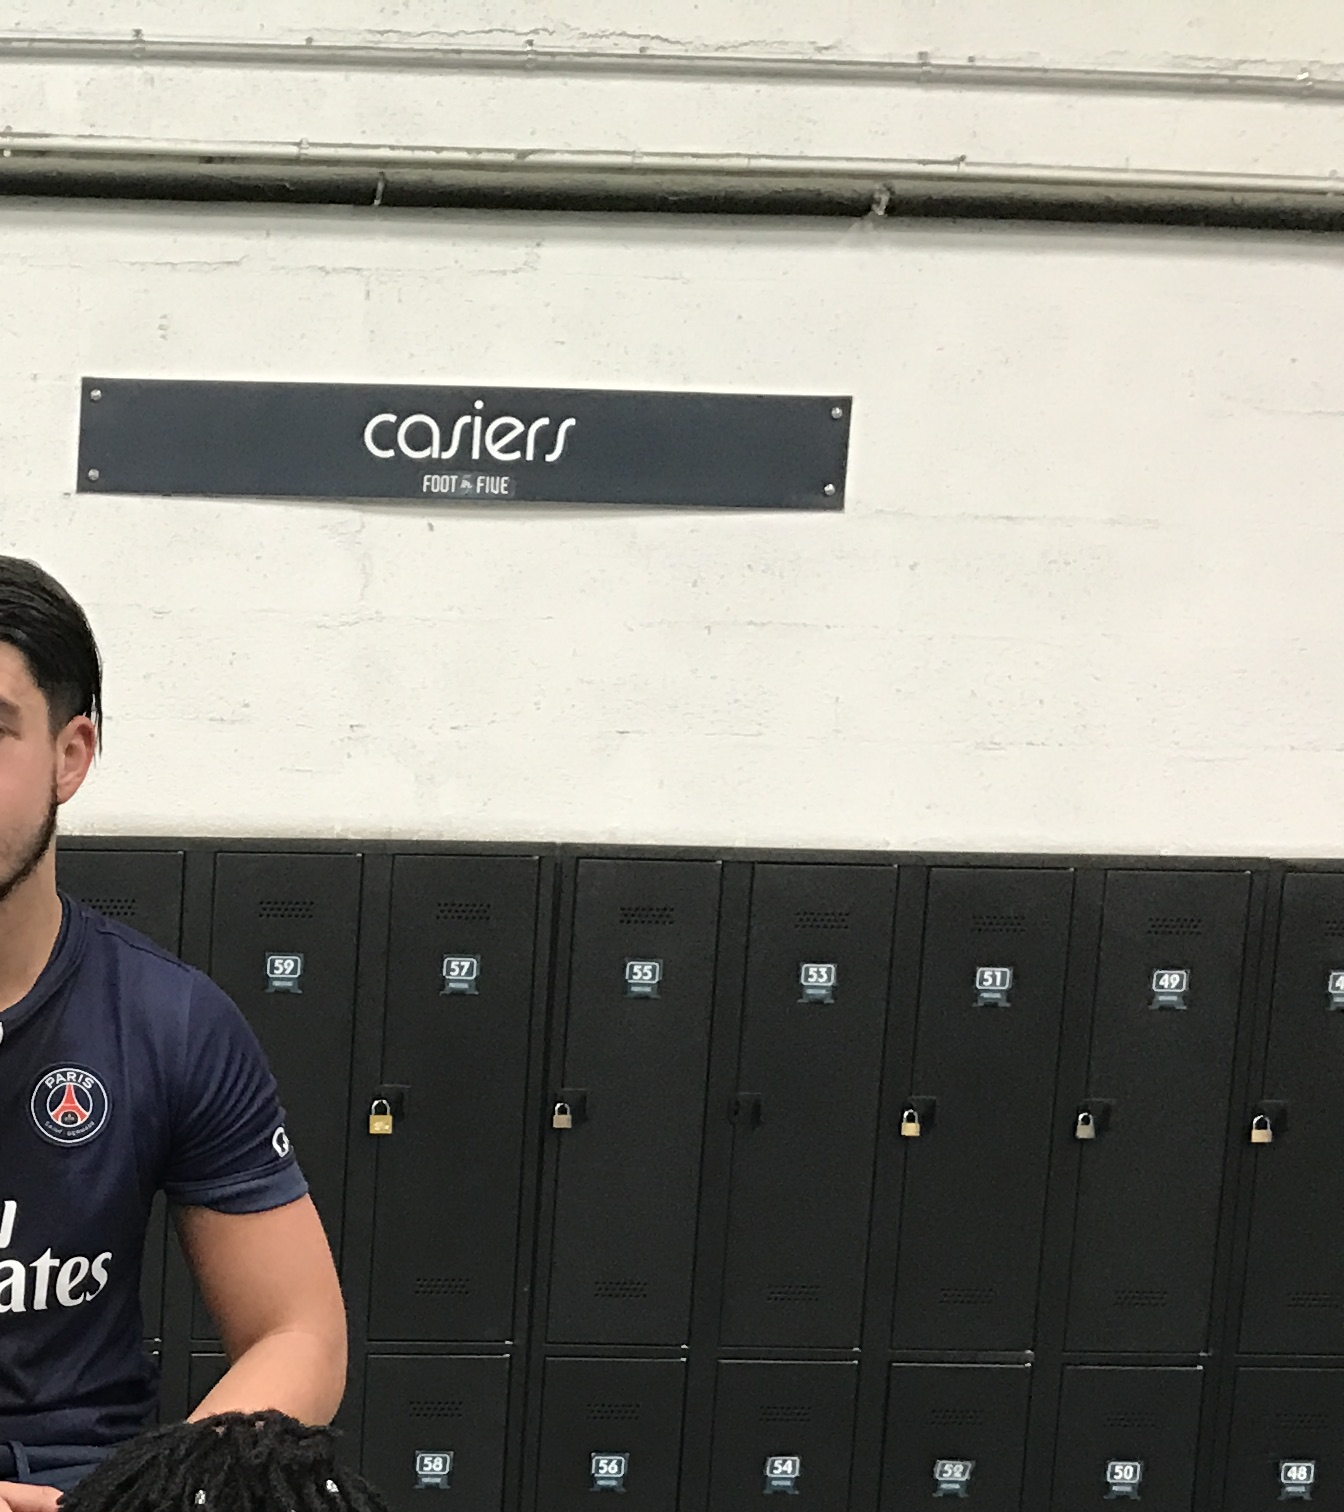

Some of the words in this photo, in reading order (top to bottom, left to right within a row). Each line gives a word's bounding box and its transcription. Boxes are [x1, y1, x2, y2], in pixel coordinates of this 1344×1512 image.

[363, 399, 576, 463] casiers
[422, 474, 459, 494] FOOT
[273, 959, 294, 975] 59
[450, 961, 470, 976] 57
[632, 965, 652, 980] 55
[808, 967, 828, 982] 53
[983, 971, 1002, 986] 51
[1158, 973, 1180, 989] 49
[44, 1071, 94, 1089] PARIS
[423, 1457, 443, 1471] 58
[600, 1459, 618, 1474] 56
[773, 1460, 792, 1474] 54
[1114, 1465, 1134, 1480] 50
[1287, 1466, 1307, 1480] 48
